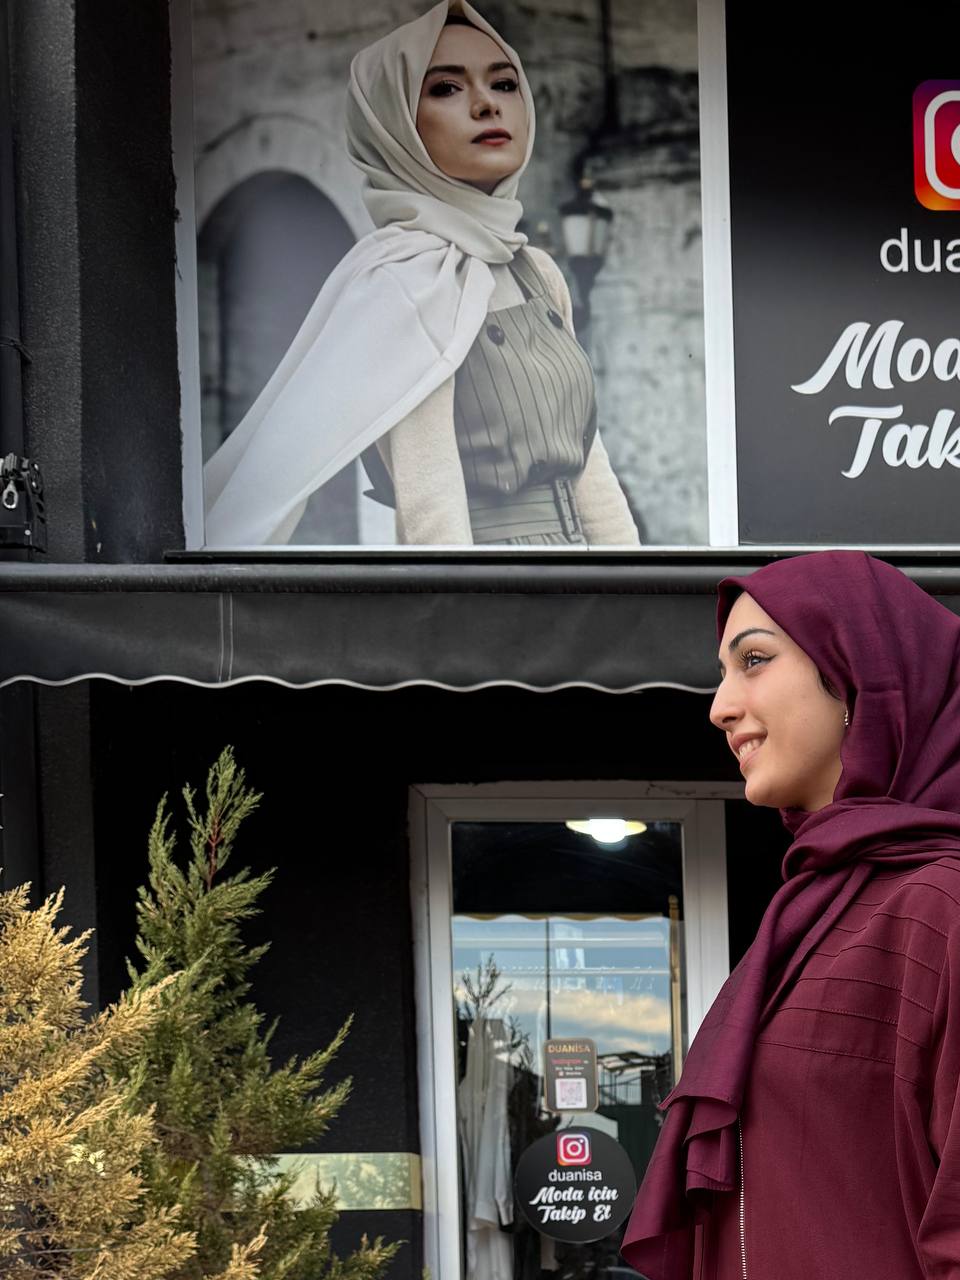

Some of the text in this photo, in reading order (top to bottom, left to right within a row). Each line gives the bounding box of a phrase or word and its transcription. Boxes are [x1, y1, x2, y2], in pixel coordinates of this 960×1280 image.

[548, 1169, 602, 1182] duanisa
[529, 1186, 619, 1205] Moda için
[537, 1205, 586, 1225] Takip
